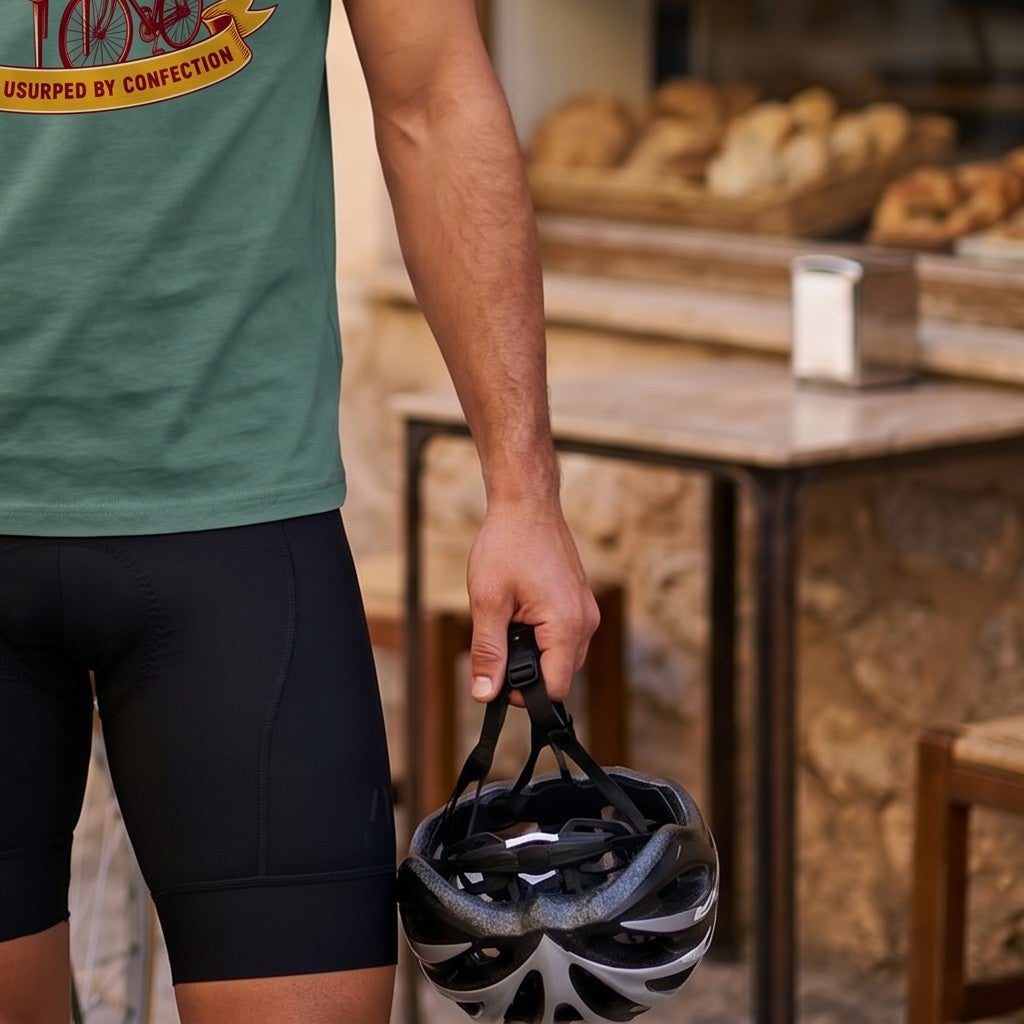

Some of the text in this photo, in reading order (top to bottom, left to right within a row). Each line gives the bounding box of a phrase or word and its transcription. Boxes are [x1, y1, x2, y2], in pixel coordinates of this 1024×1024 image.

[3, 80, 87, 100] USURPED
[94, 79, 116, 98] BY
[123, 45, 234, 94] CONFECTION
